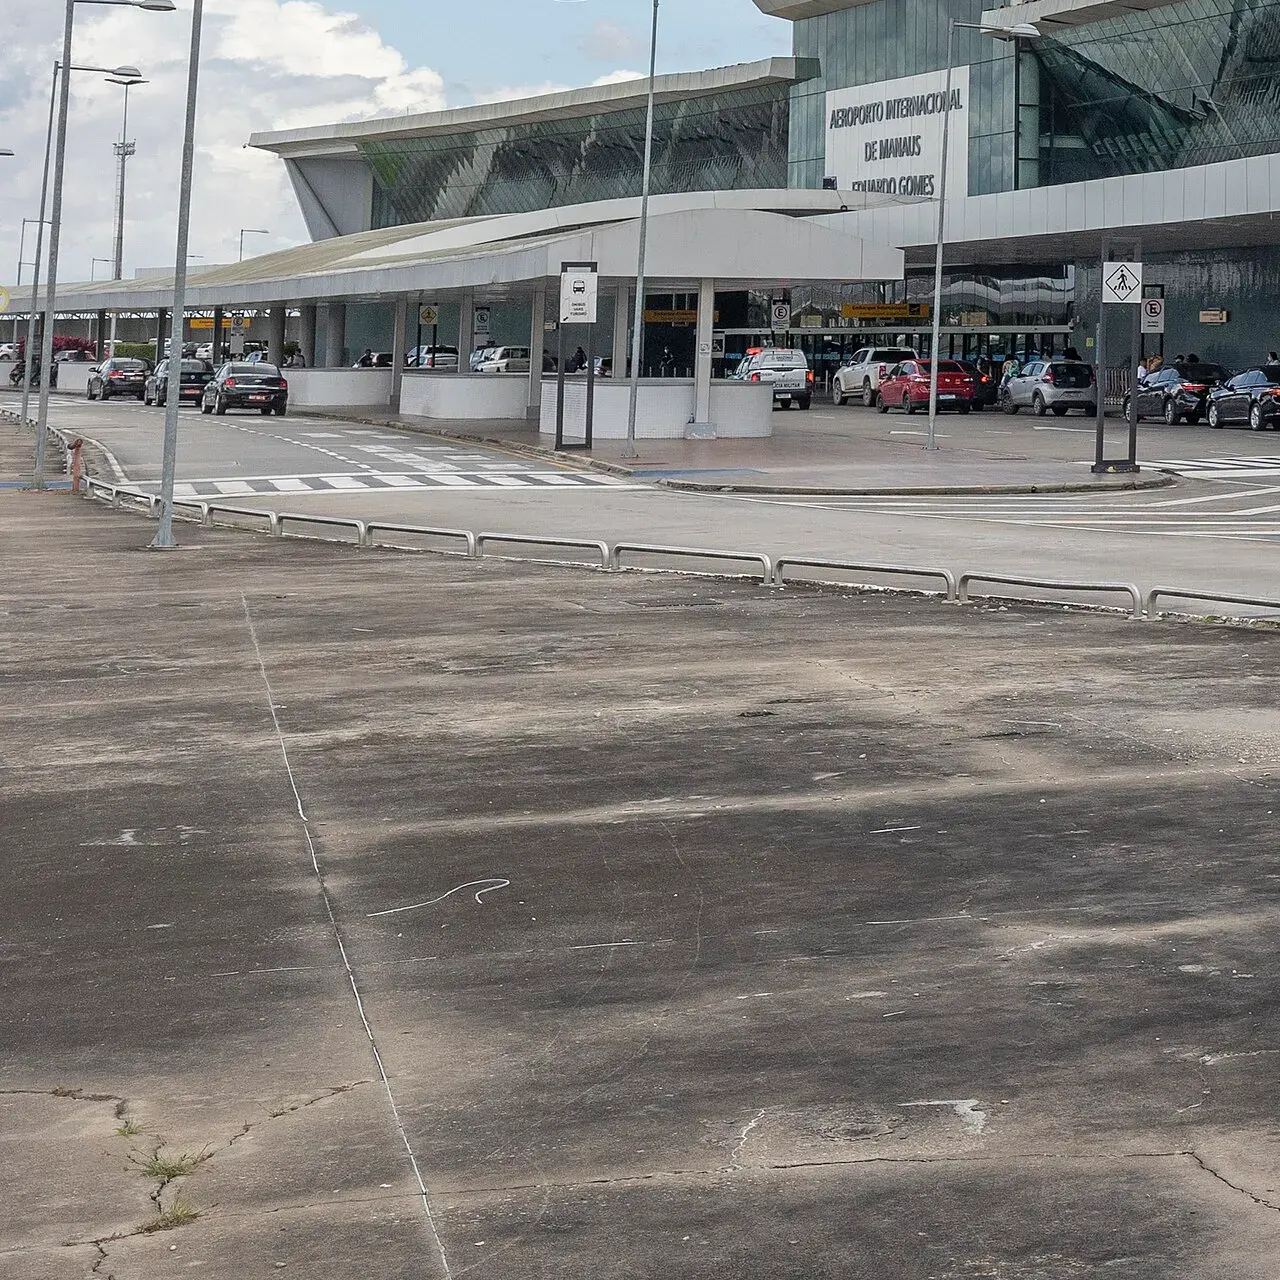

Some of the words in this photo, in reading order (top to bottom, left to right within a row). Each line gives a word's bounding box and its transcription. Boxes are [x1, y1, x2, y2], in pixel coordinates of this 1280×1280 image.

[829, 100, 884, 129] AEROPORTO
[864, 140, 878, 162] DE
[879, 134, 921, 160] MANAUS
[899, 174, 935, 196] GOMES
